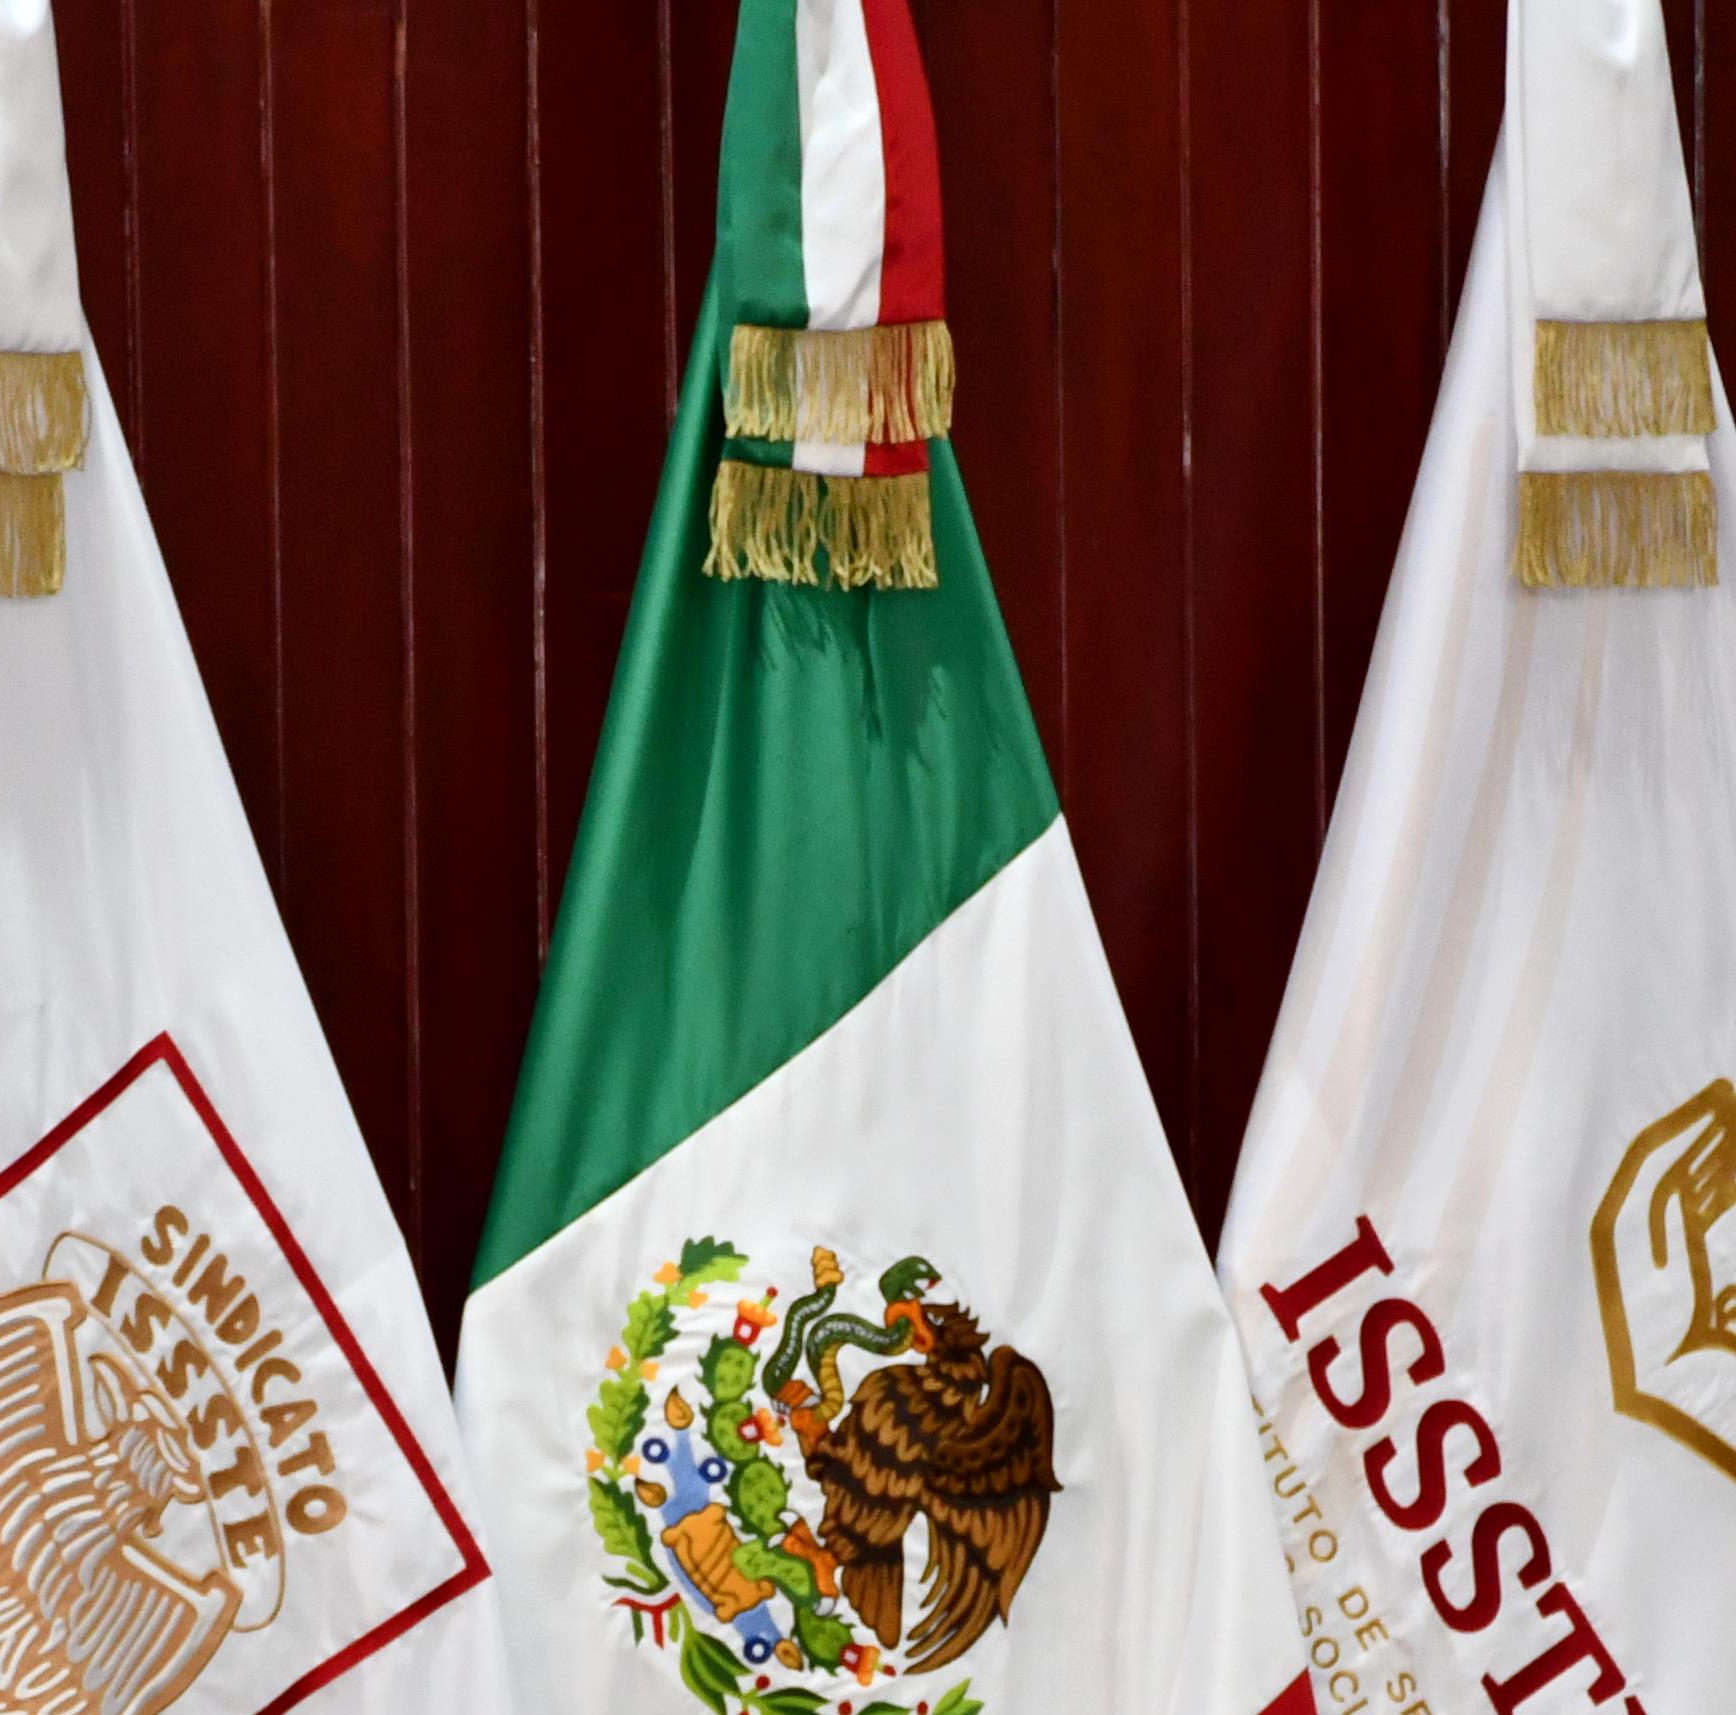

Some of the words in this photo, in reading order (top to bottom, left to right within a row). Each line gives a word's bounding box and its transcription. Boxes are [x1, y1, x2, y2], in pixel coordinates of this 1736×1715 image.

[87, 1254, 279, 1572] ISSSTE
[141, 1205, 347, 1536] SINDICATO
[1337, 1585, 1392, 1652] DE
